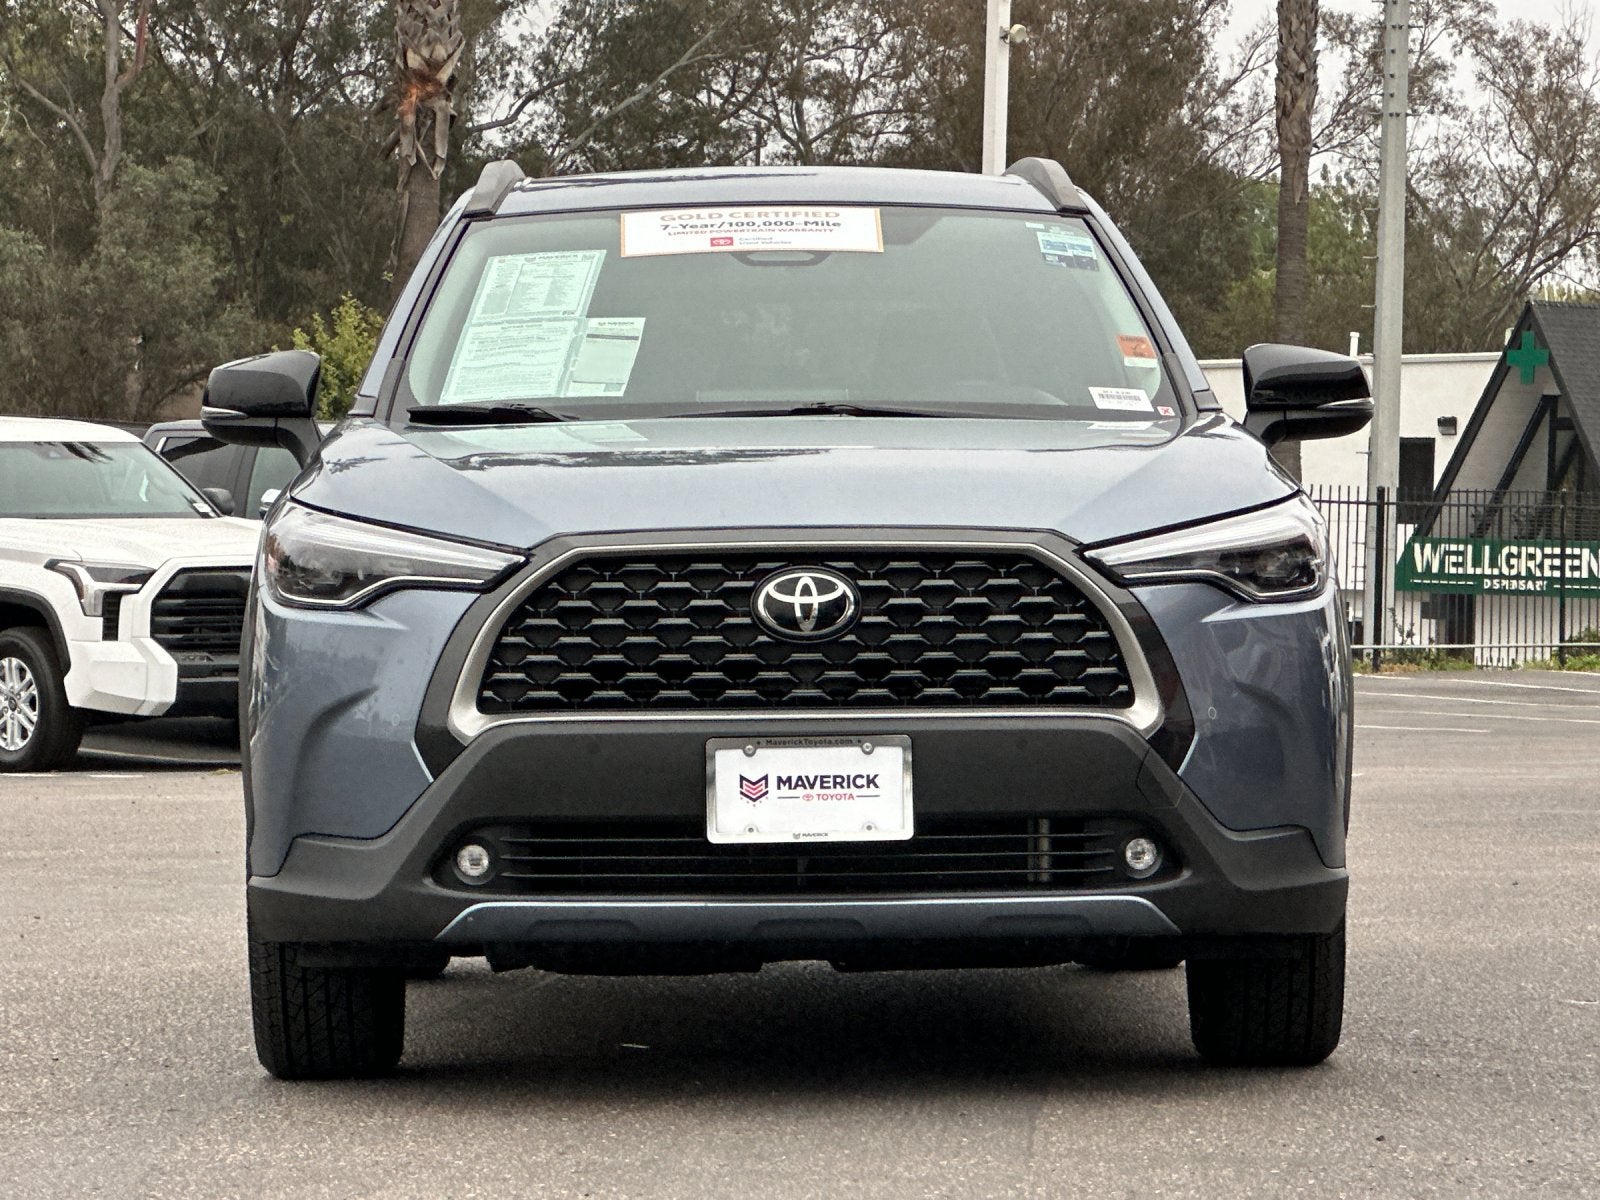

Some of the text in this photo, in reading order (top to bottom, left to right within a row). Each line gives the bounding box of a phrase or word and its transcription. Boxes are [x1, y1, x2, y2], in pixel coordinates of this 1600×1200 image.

[660, 213, 723, 221] GOLD
[660, 221, 842, 230] 7-Year/100,000-Mile
[1413, 543, 1600, 579] WELLGREEN
[1483, 578, 1548, 591] DSPENSARY
[766, 738, 853, 747] MaverickToyota.com
[776, 774, 880, 790] MAVERICK
[816, 793, 855, 801] TOYOTA
